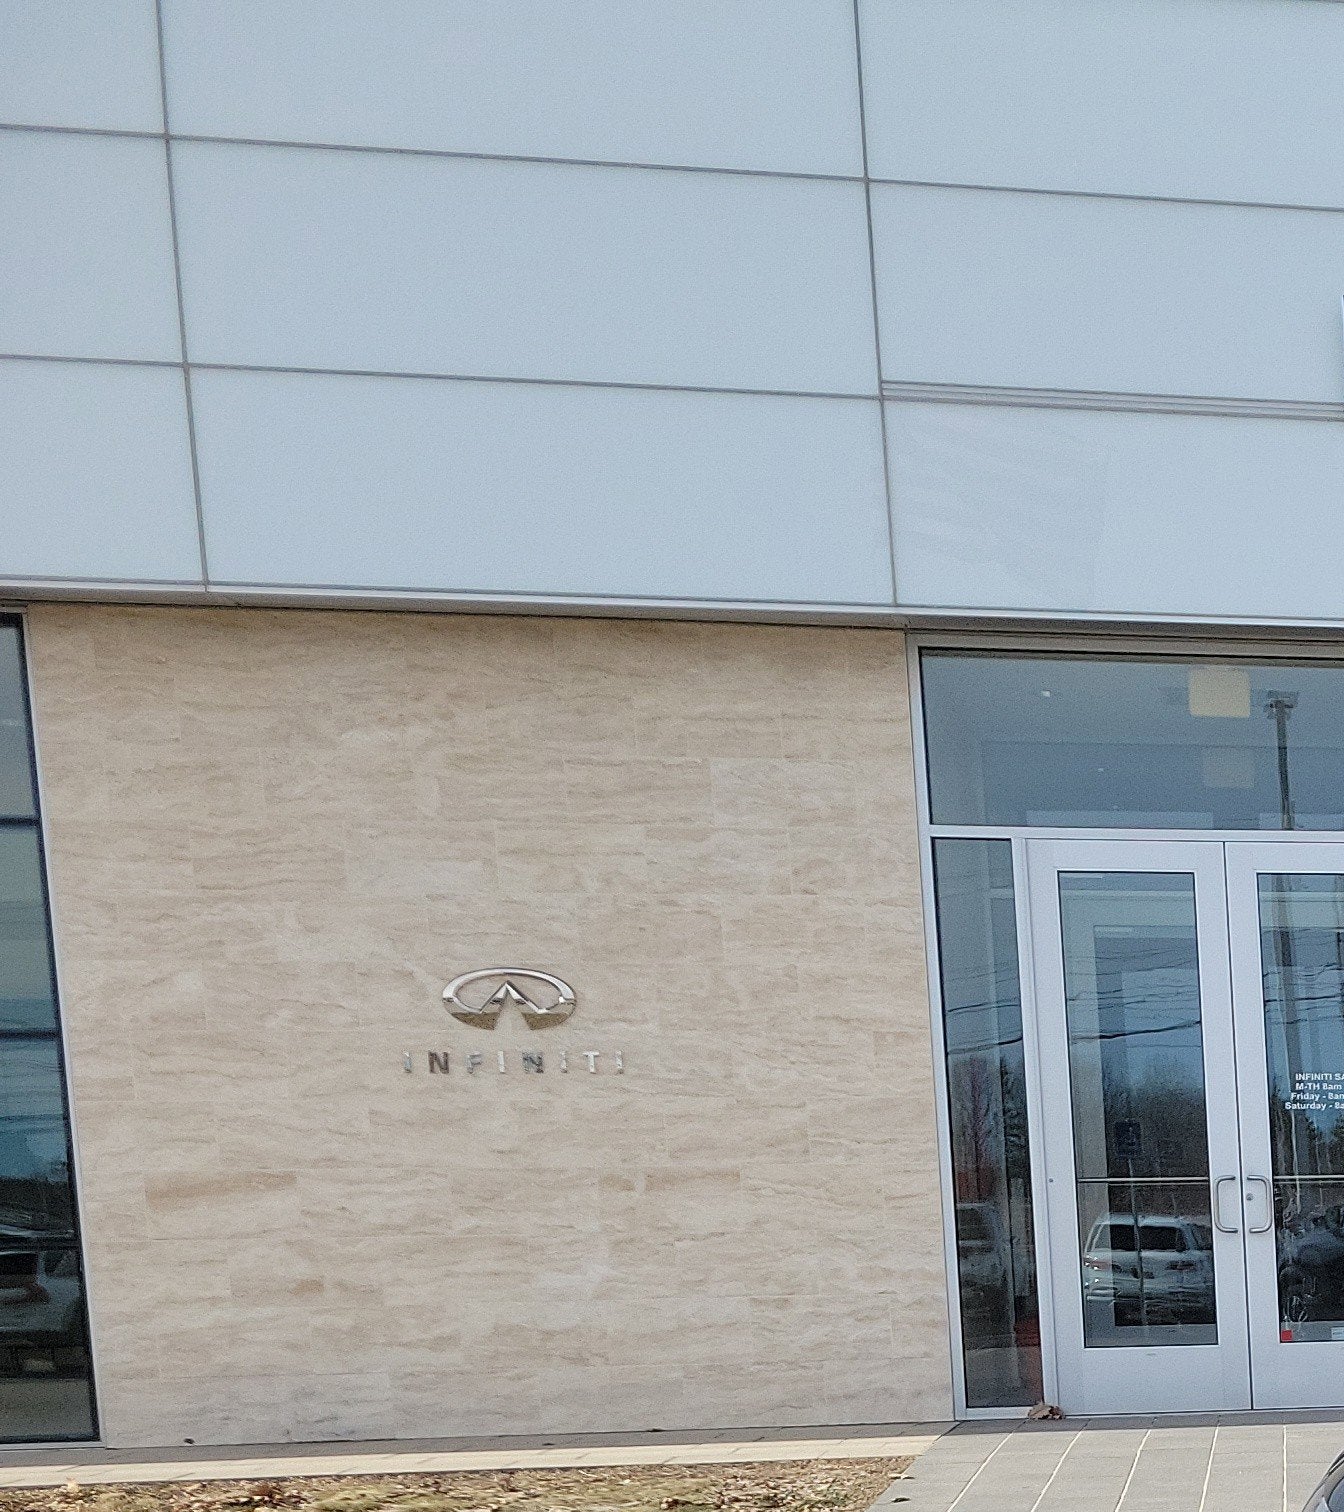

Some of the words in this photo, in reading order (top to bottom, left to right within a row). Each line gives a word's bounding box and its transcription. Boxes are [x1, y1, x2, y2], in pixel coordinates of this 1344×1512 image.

[402, 1050, 625, 1075] INFINITI
[1295, 1073, 1332, 1081] INFINITI
[1290, 1092, 1320, 1101] Friday
[1284, 1102, 1327, 1111] Saturday
